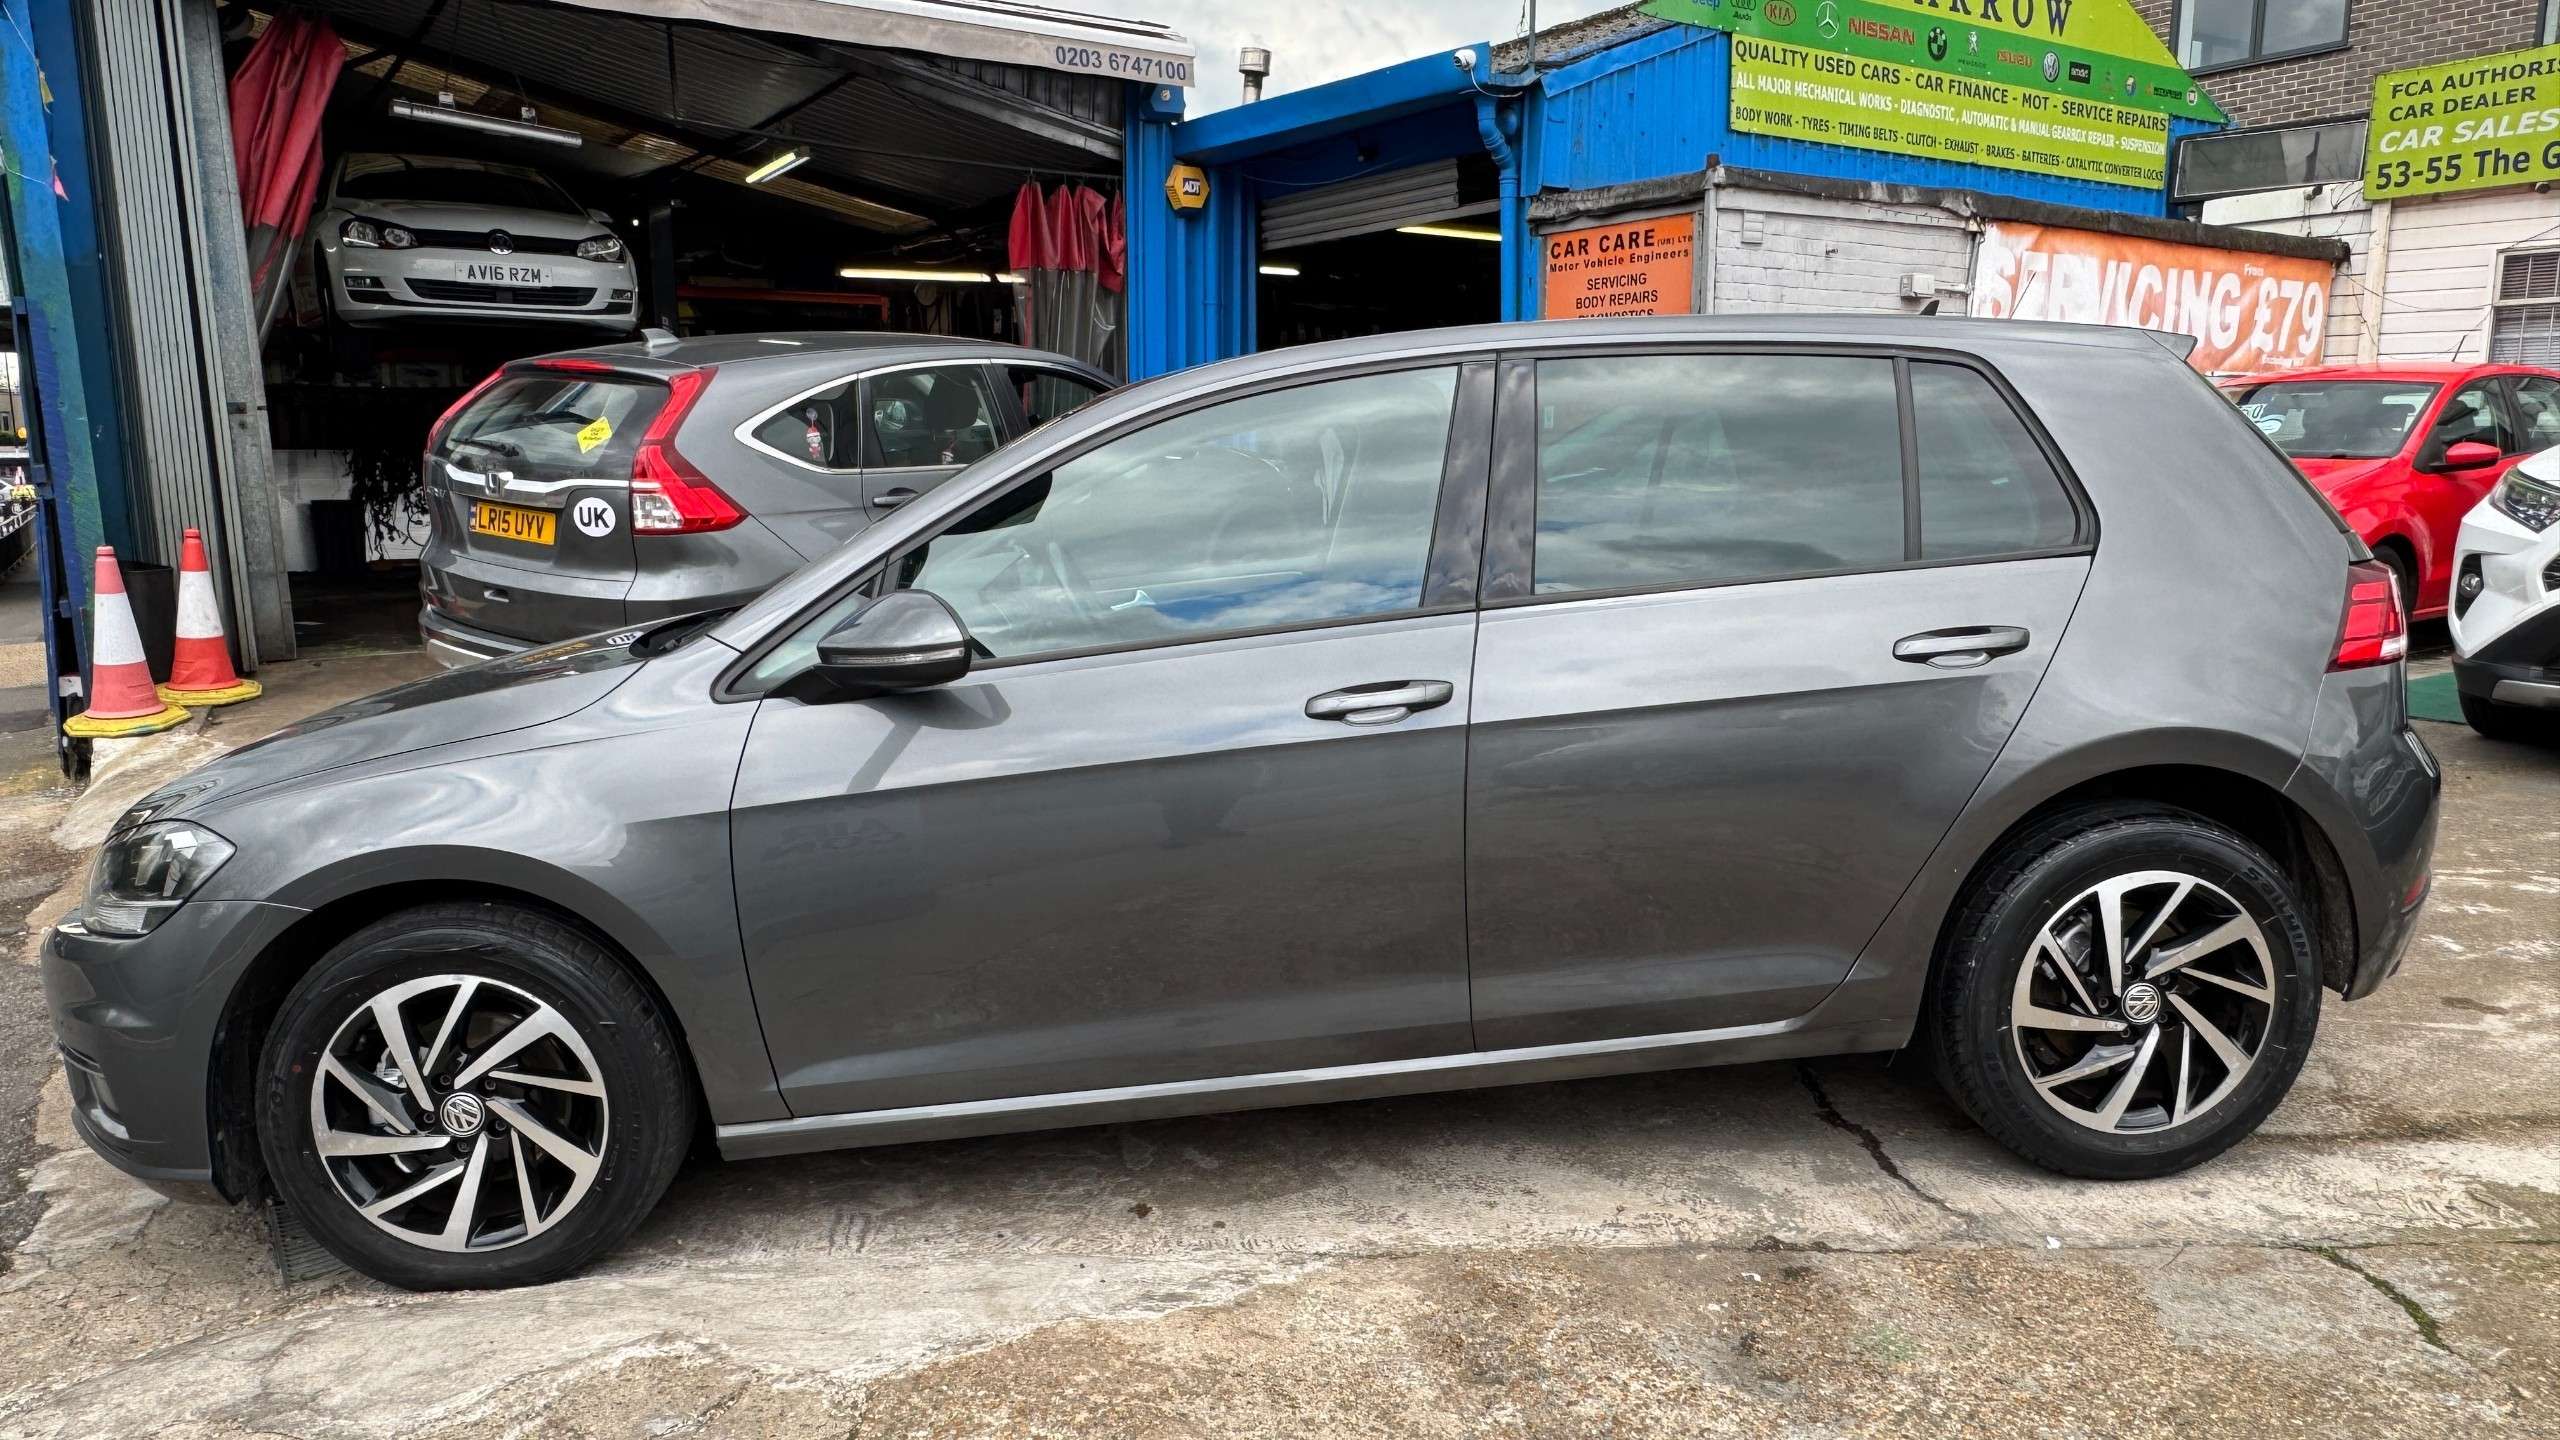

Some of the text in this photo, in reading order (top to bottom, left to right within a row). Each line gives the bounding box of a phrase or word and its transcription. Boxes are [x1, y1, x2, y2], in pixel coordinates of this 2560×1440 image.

[1769, 4, 1791, 20] KIA
[1848, 17, 1915, 46] NISSAN
[1055, 45, 1187, 81] 0203 6747100
[2391, 57, 2560, 99] FCA AUTHORI
[1735, 40, 1809, 69] QUALITY
[1815, 54, 1856, 76] USED
[1861, 63, 1901, 84] CARS
[1916, 73, 1944, 93] CAR
[1949, 79, 2009, 104] FINANCE
[2022, 92, 2050, 111] MOT
[2062, 100, 2113, 123] SERVICE
[2117, 110, 2167, 131] REPAIRS
[1736, 72, 1755, 89] ALL
[1758, 75, 1791, 96] MAJOR
[1794, 81, 1856, 106] MECHANICAL
[1859, 92, 1892, 112] WORKS
[1961, 109, 2009, 131] AUTOMATIC
[2018, 119, 2050, 138] MANUAL
[2052, 125, 2086, 145] GEARBOX
[2087, 131, 2115, 148] REPAIR
[2121, 137, 2165, 155] SUSPENSION
[2389, 86, 2537, 122] CAR DEALER
[1735, 106, 1762, 123] BODY
[1764, 110, 1793, 128] WORK
[1802, 116, 1829, 133] TYRES
[1838, 121, 1871, 138] TIMING
[1873, 126, 1899, 142] BELTS
[1906, 132, 1937, 148] CLUTCH
[1944, 138, 1979, 155] EXHAUST
[1986, 144, 2015, 160] BRAKES
[2022, 150, 2060, 167] BATTERIES
[2066, 156, 2103, 172] CATALYTIC
[2104, 162, 2142, 179] CONVERTER
[2143, 169, 2164, 181] LOCKS
[2379, 107, 2560, 153] CAR SALES
[2376, 153, 2463, 190] 53-55
[2473, 147, 2530, 178] The
[1183, 180, 1200, 194] ADT
[1550, 237, 1589, 260] CAR
[1599, 228, 1656, 253] CARE
[1678, 234, 1693, 244] LTD
[1550, 248, 1689, 273] Motor Vehicle Engineers
[467, 264, 542, 283] AV16 RZM
[1586, 272, 1647, 292] SERVICING
[1575, 289, 1659, 310] BODY REPAIRS
[2250, 276, 2325, 356] £79
[478, 506, 545, 540] LR15 UYV
[579, 506, 610, 529] UK
